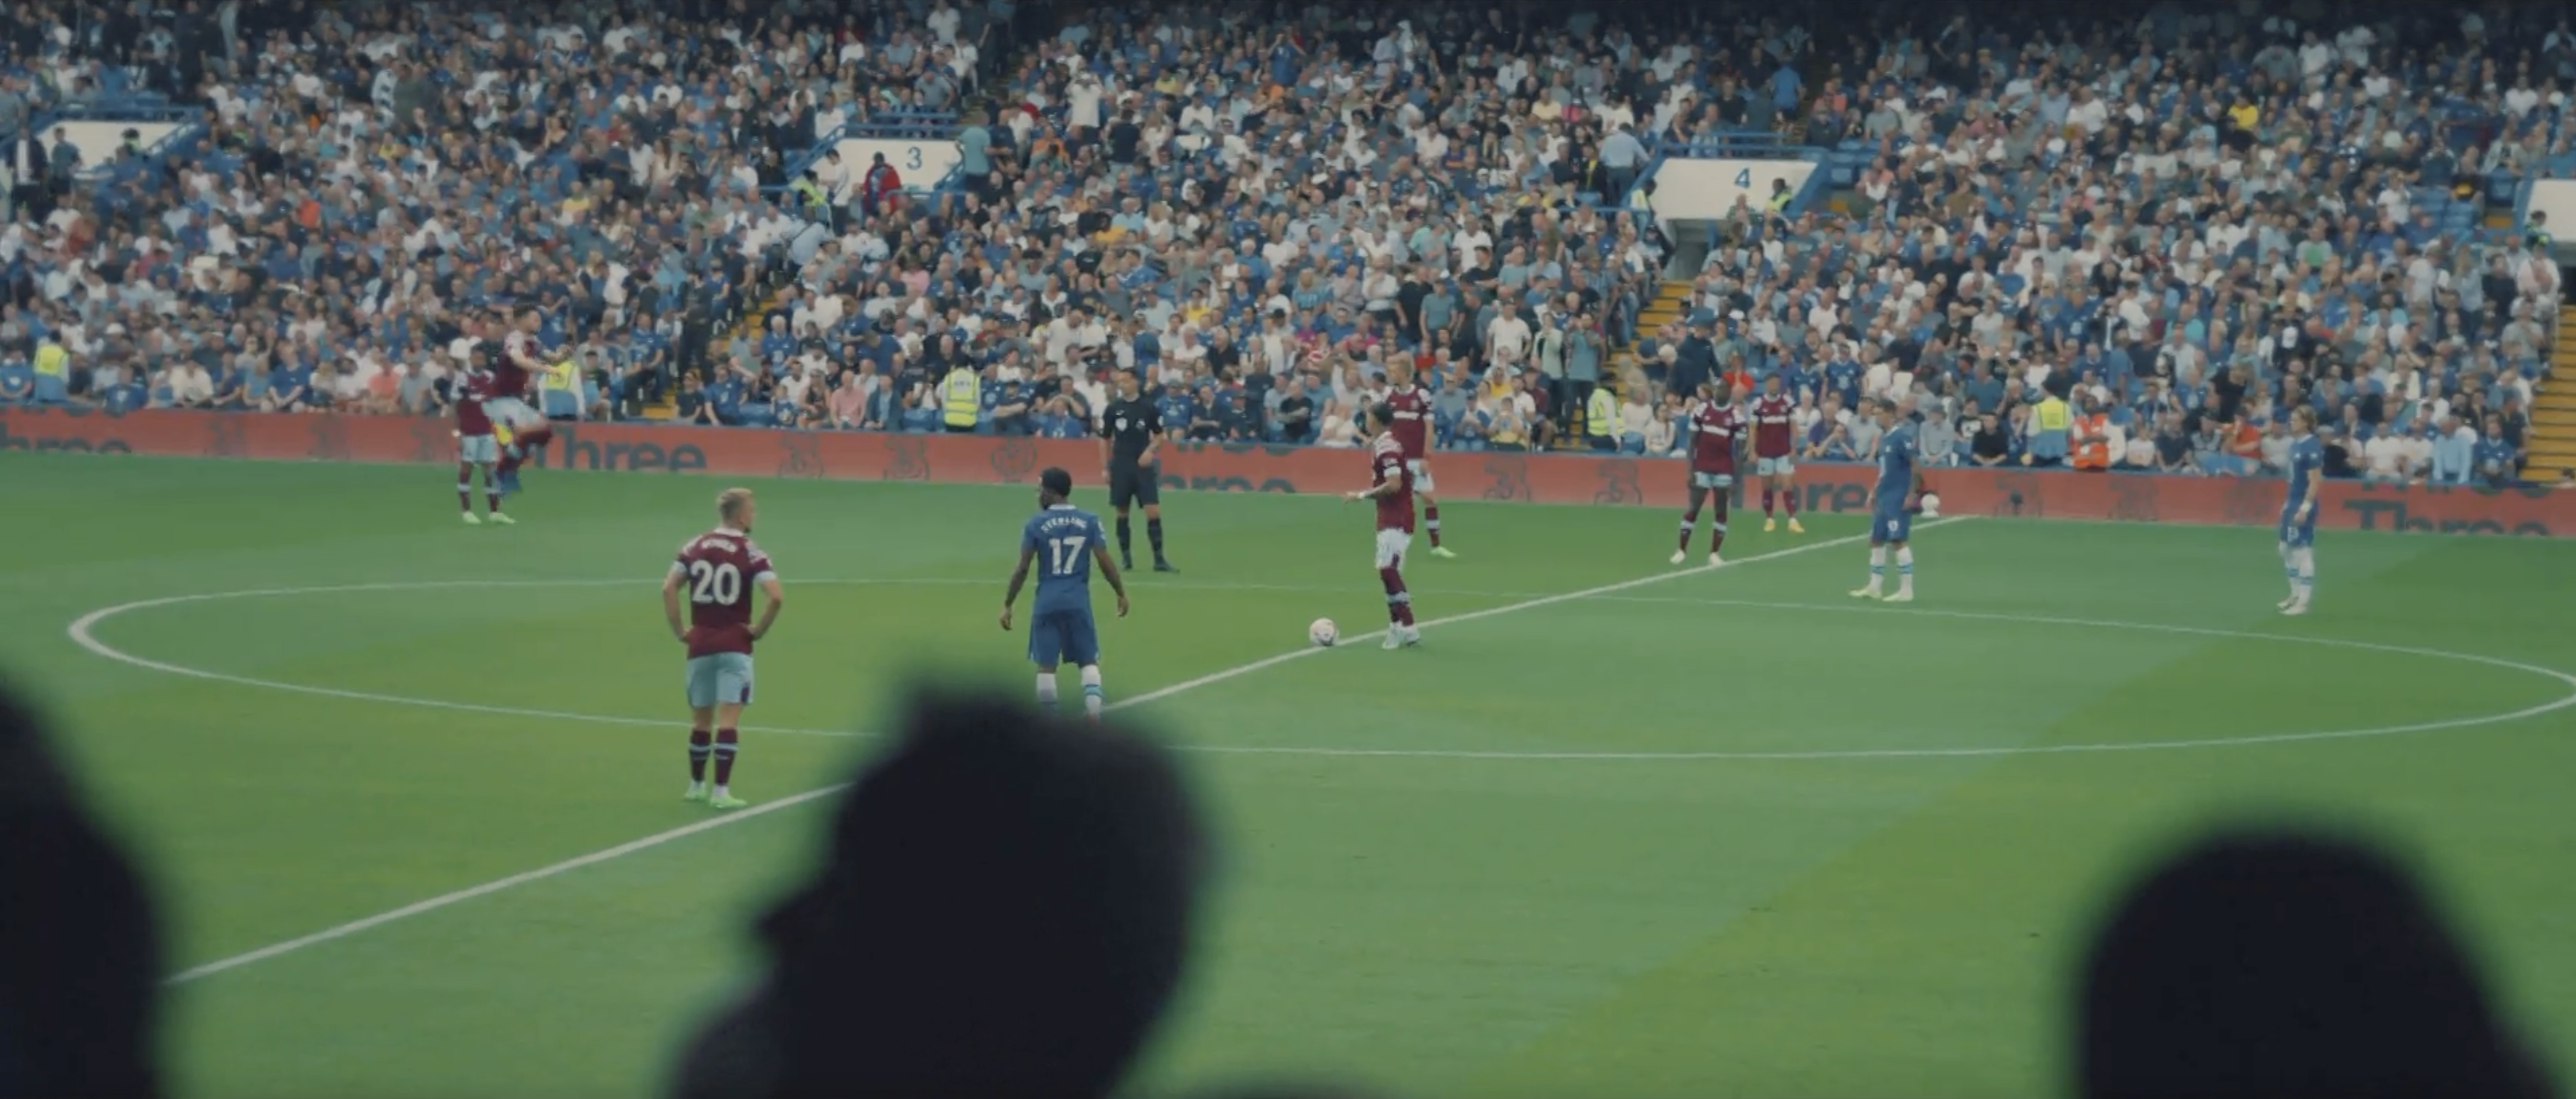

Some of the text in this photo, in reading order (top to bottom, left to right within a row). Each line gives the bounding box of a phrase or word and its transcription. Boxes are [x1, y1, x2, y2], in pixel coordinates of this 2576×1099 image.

[906, 146, 923, 170] 3
[1734, 167, 1750, 189] 4
[1048, 536, 1087, 574] 17
[691, 559, 741, 605] 20
